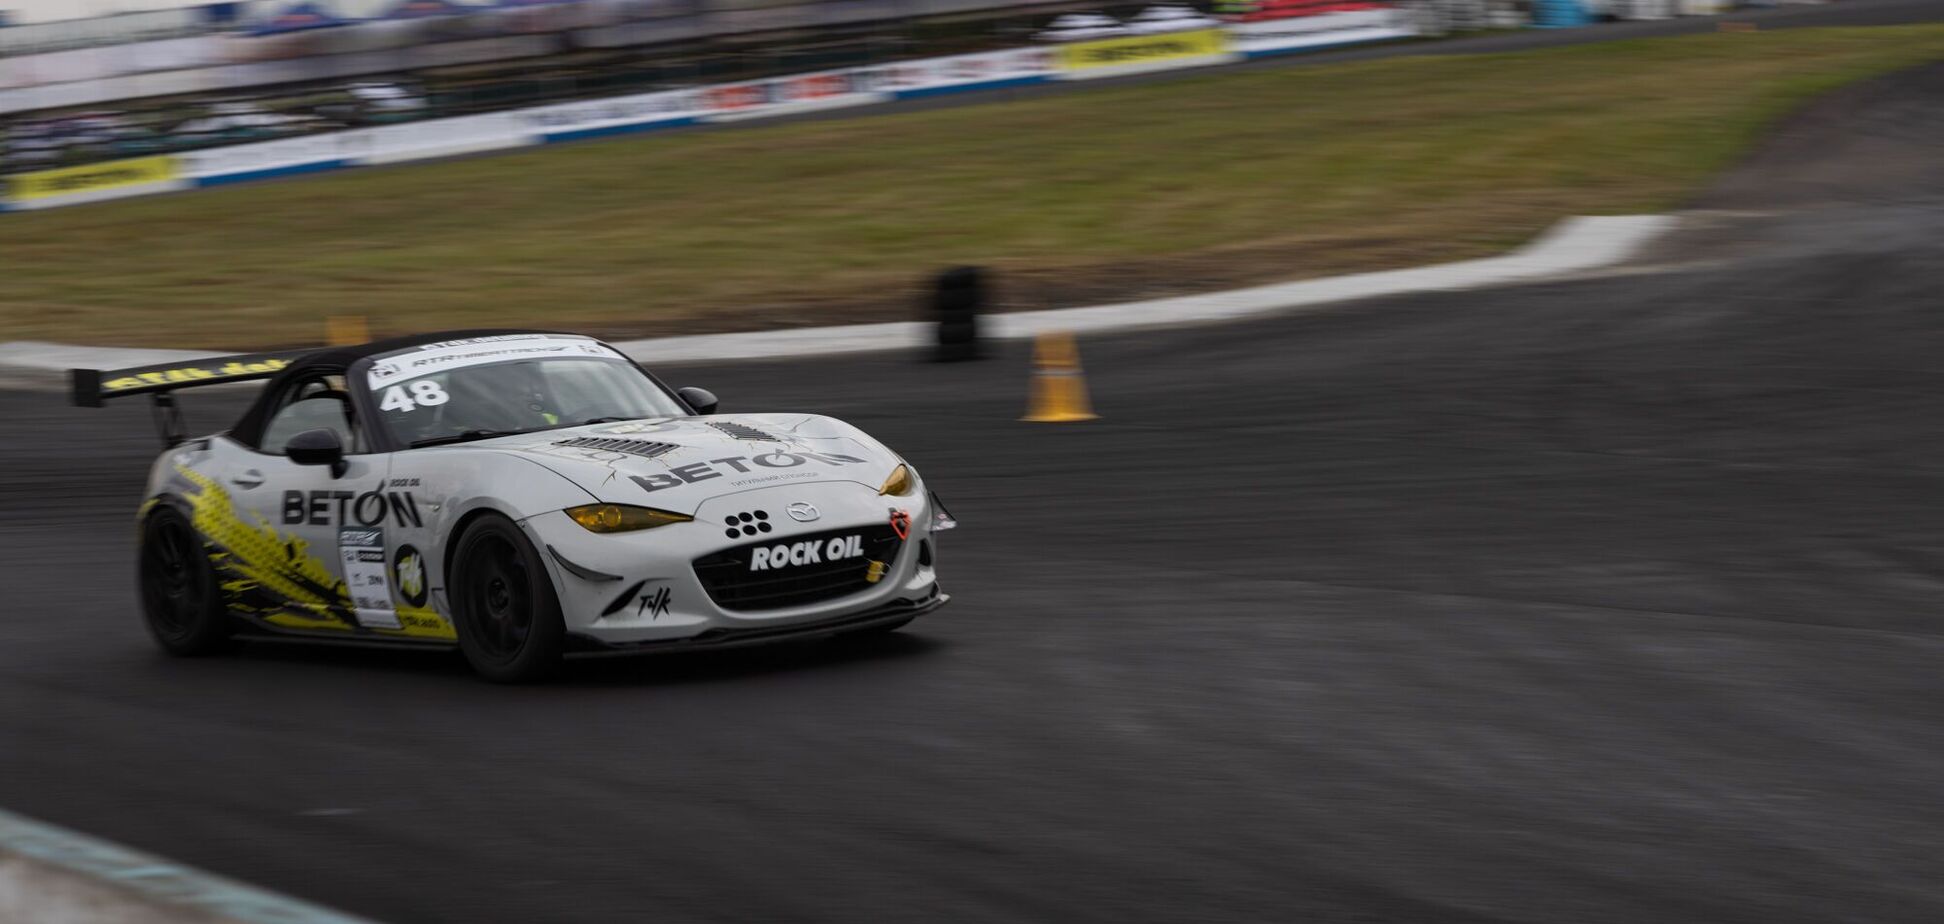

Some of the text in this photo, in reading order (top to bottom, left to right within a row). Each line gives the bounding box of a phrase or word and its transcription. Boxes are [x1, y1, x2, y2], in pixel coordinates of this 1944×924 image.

[379, 379, 450, 413] 48
[750, 535, 864, 571] ROCK OIL
